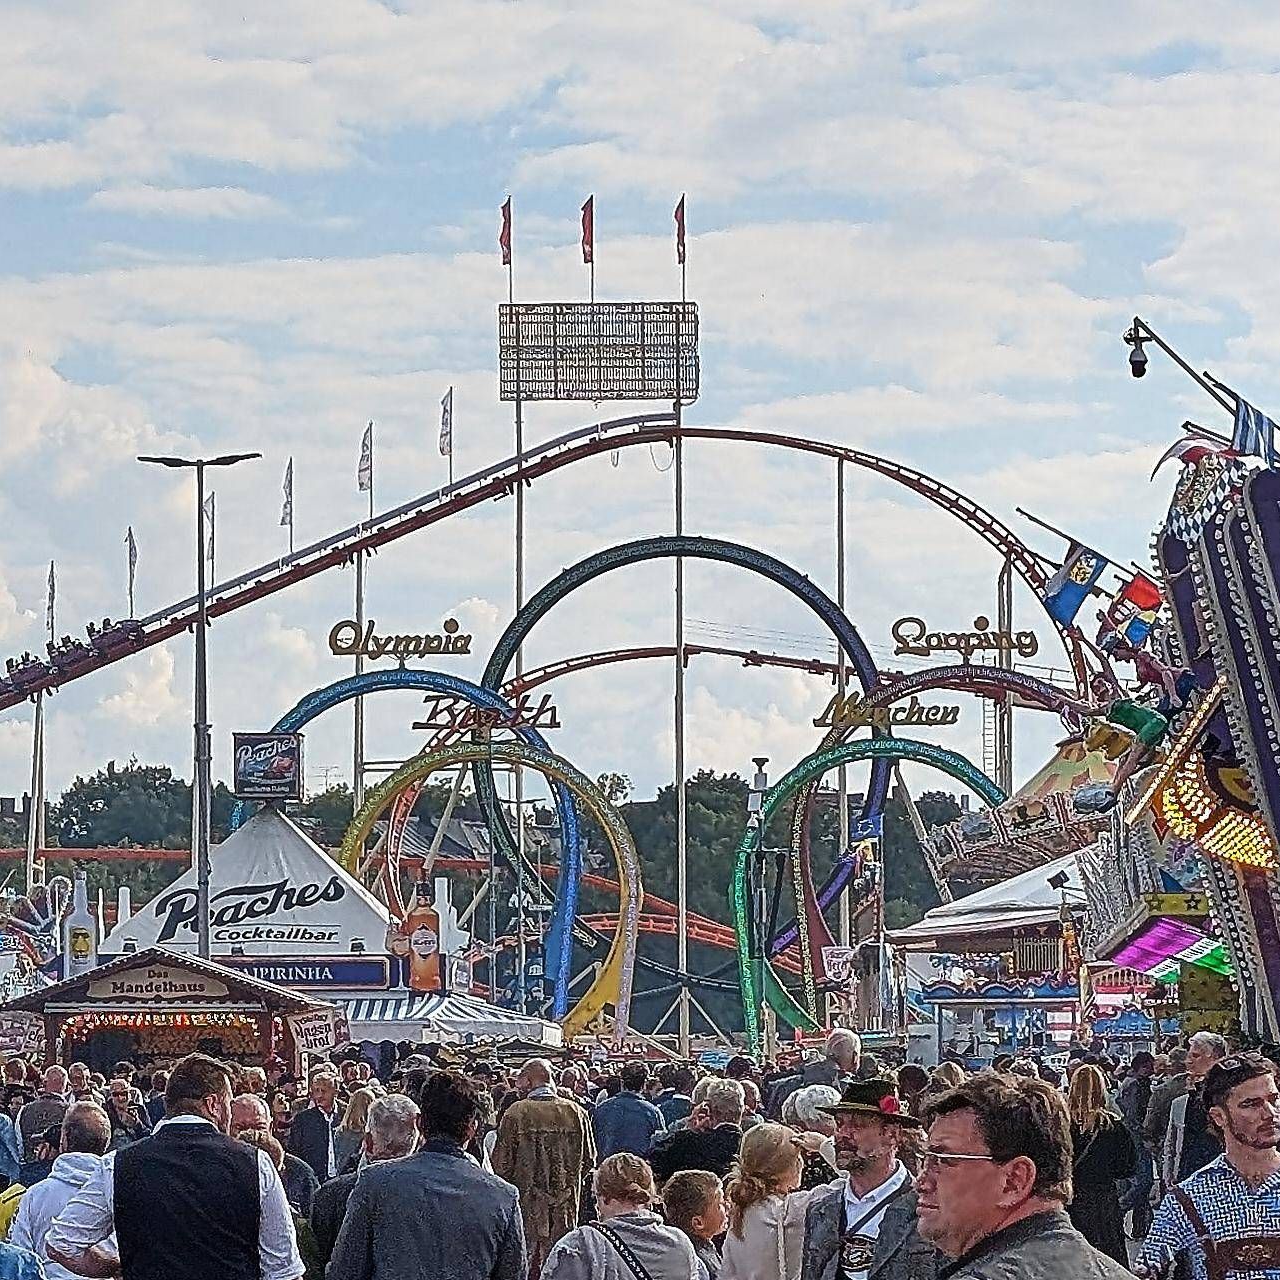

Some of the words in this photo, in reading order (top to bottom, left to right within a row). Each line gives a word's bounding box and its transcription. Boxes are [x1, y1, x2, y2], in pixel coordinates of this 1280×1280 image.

[328, 618, 472, 660] Olympia
[892, 616, 1038, 658] Looping
[155, 876, 346, 944] Peaches
[214, 925, 339, 942] Cocktailbar
[112, 980, 206, 994] Mandelhaus
[147, 969, 168, 979] Das
